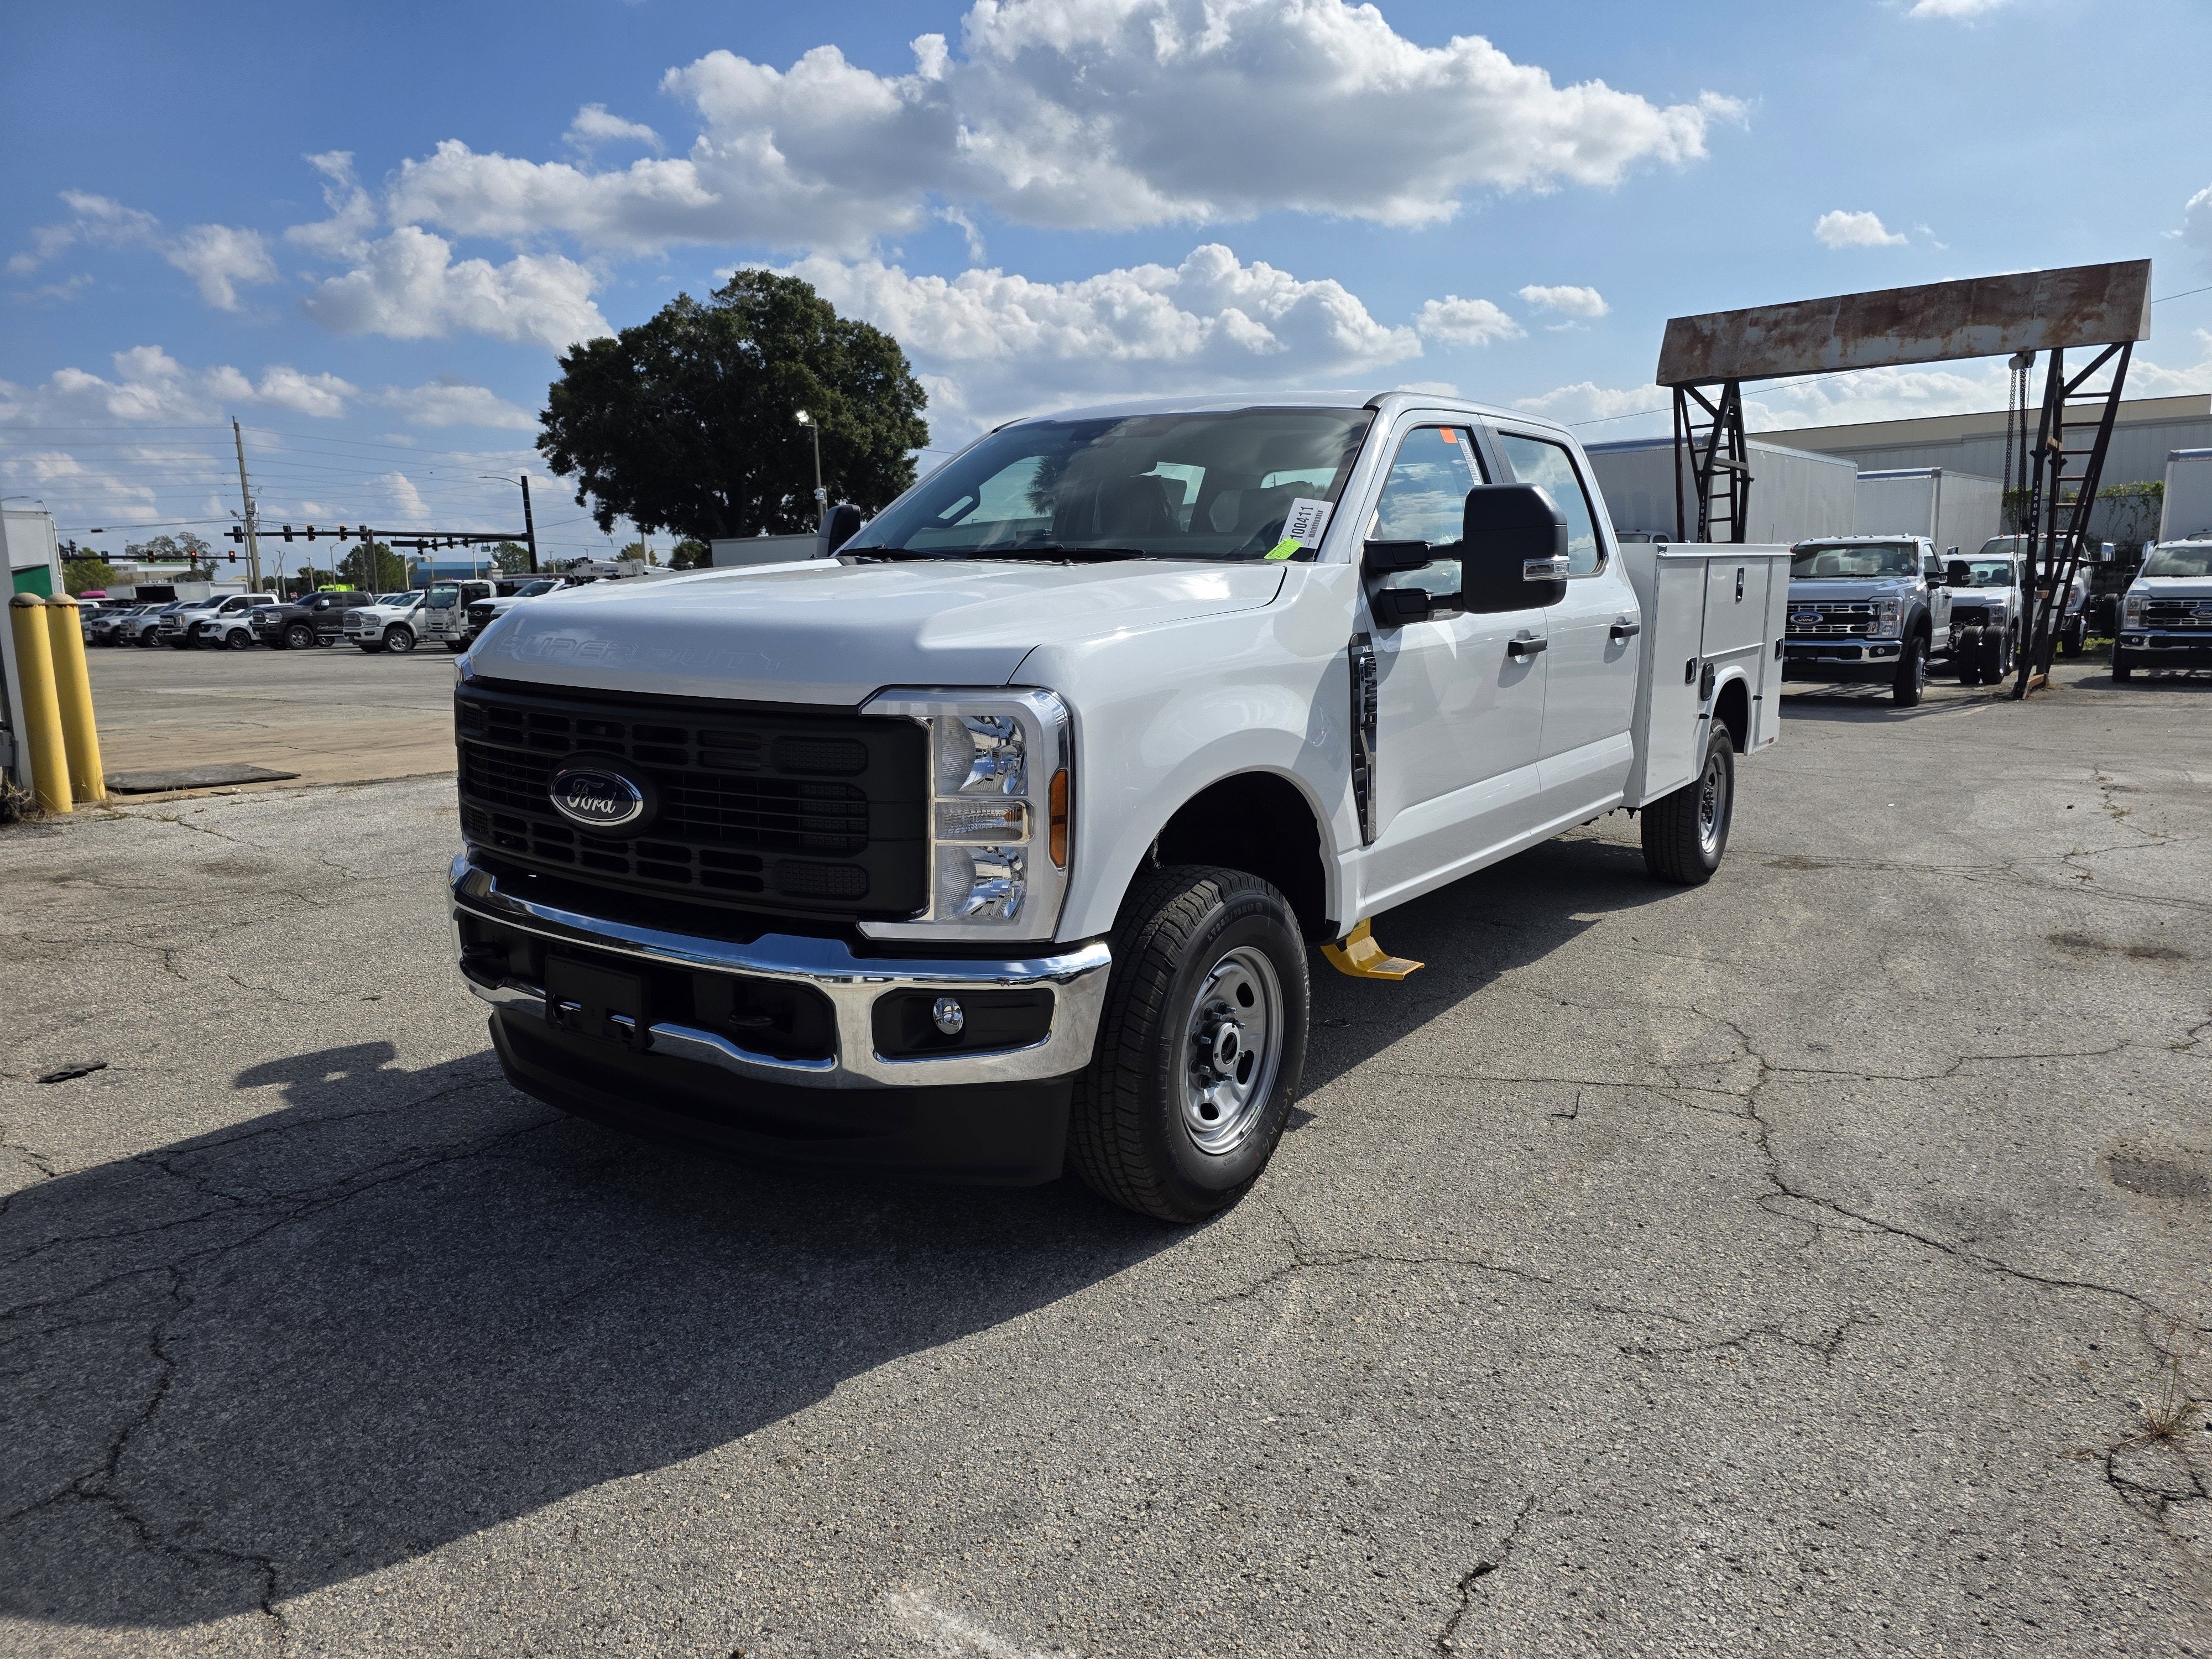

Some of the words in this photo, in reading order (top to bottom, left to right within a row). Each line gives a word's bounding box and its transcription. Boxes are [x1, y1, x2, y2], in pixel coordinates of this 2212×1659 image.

[1290, 507, 1313, 539] 100411
[497, 634, 641, 662] SUPER
[645, 646, 783, 671] DUTY
[567, 778, 617, 814] Ford
